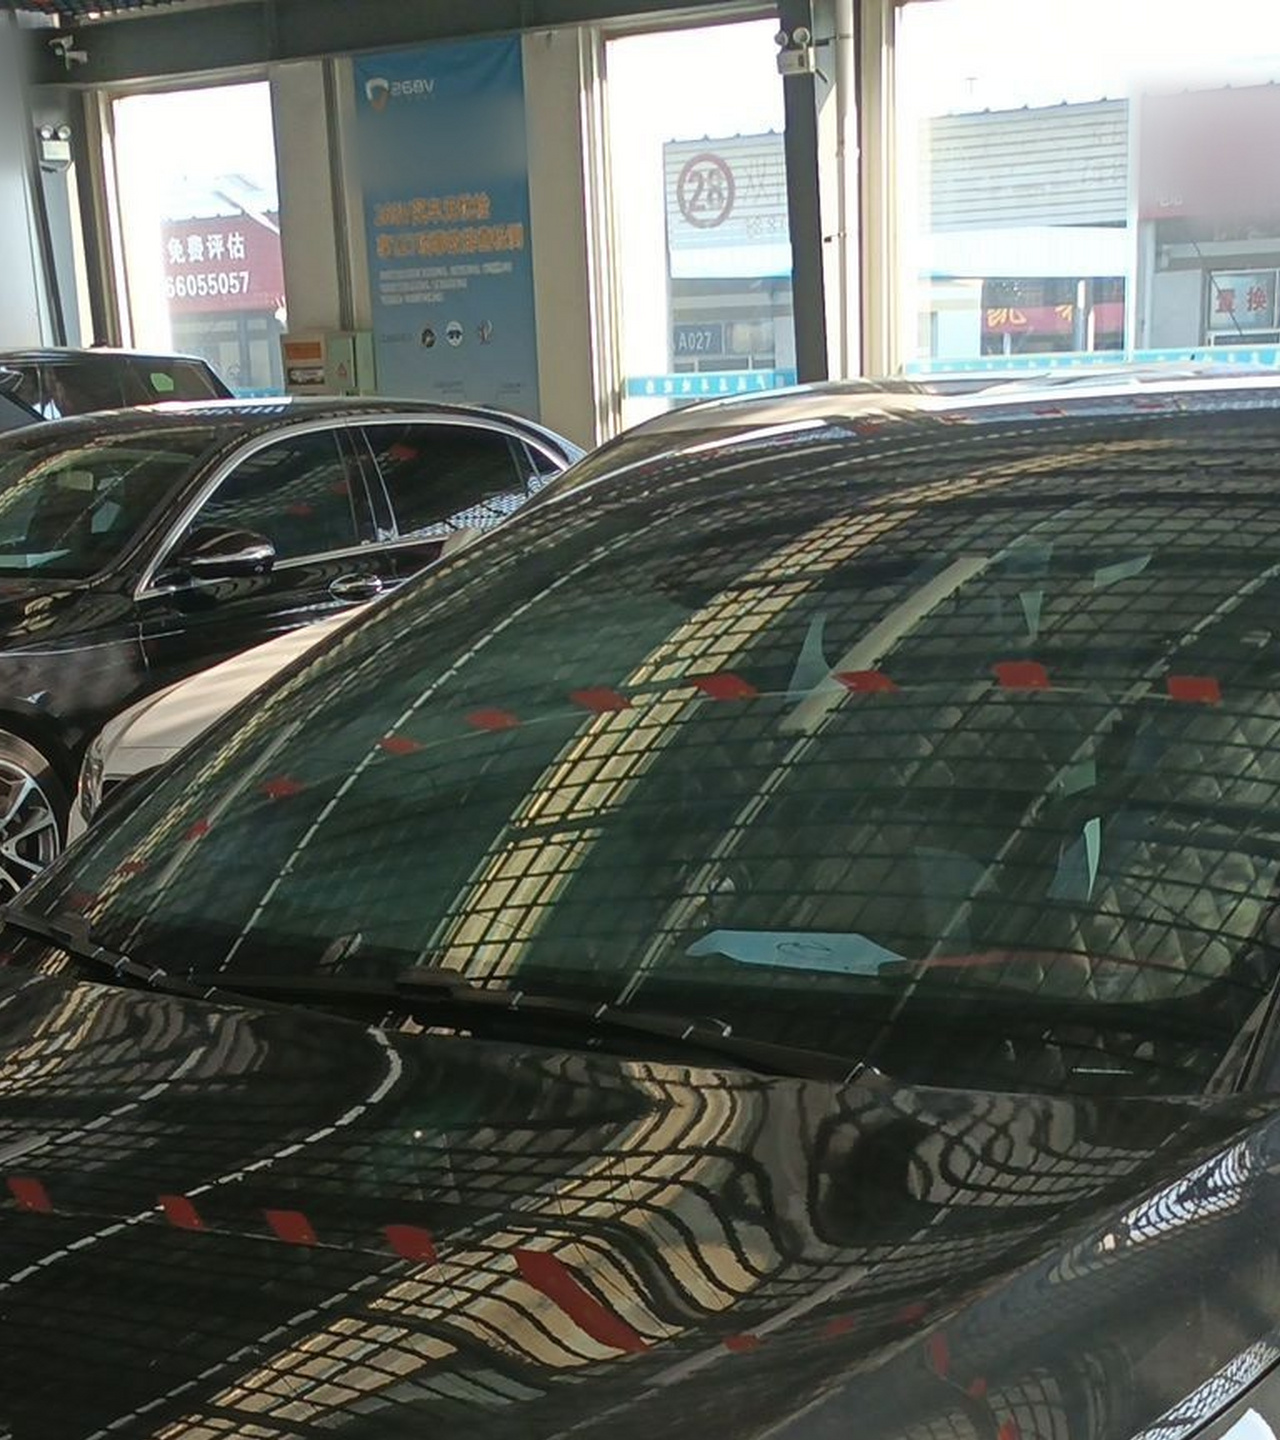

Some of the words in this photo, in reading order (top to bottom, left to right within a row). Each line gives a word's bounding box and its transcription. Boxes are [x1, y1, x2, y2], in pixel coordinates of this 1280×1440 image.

[168, 232, 245, 263] 免费评估
[1214, 286, 1268, 314] 置换
[678, 332, 712, 350] A027
